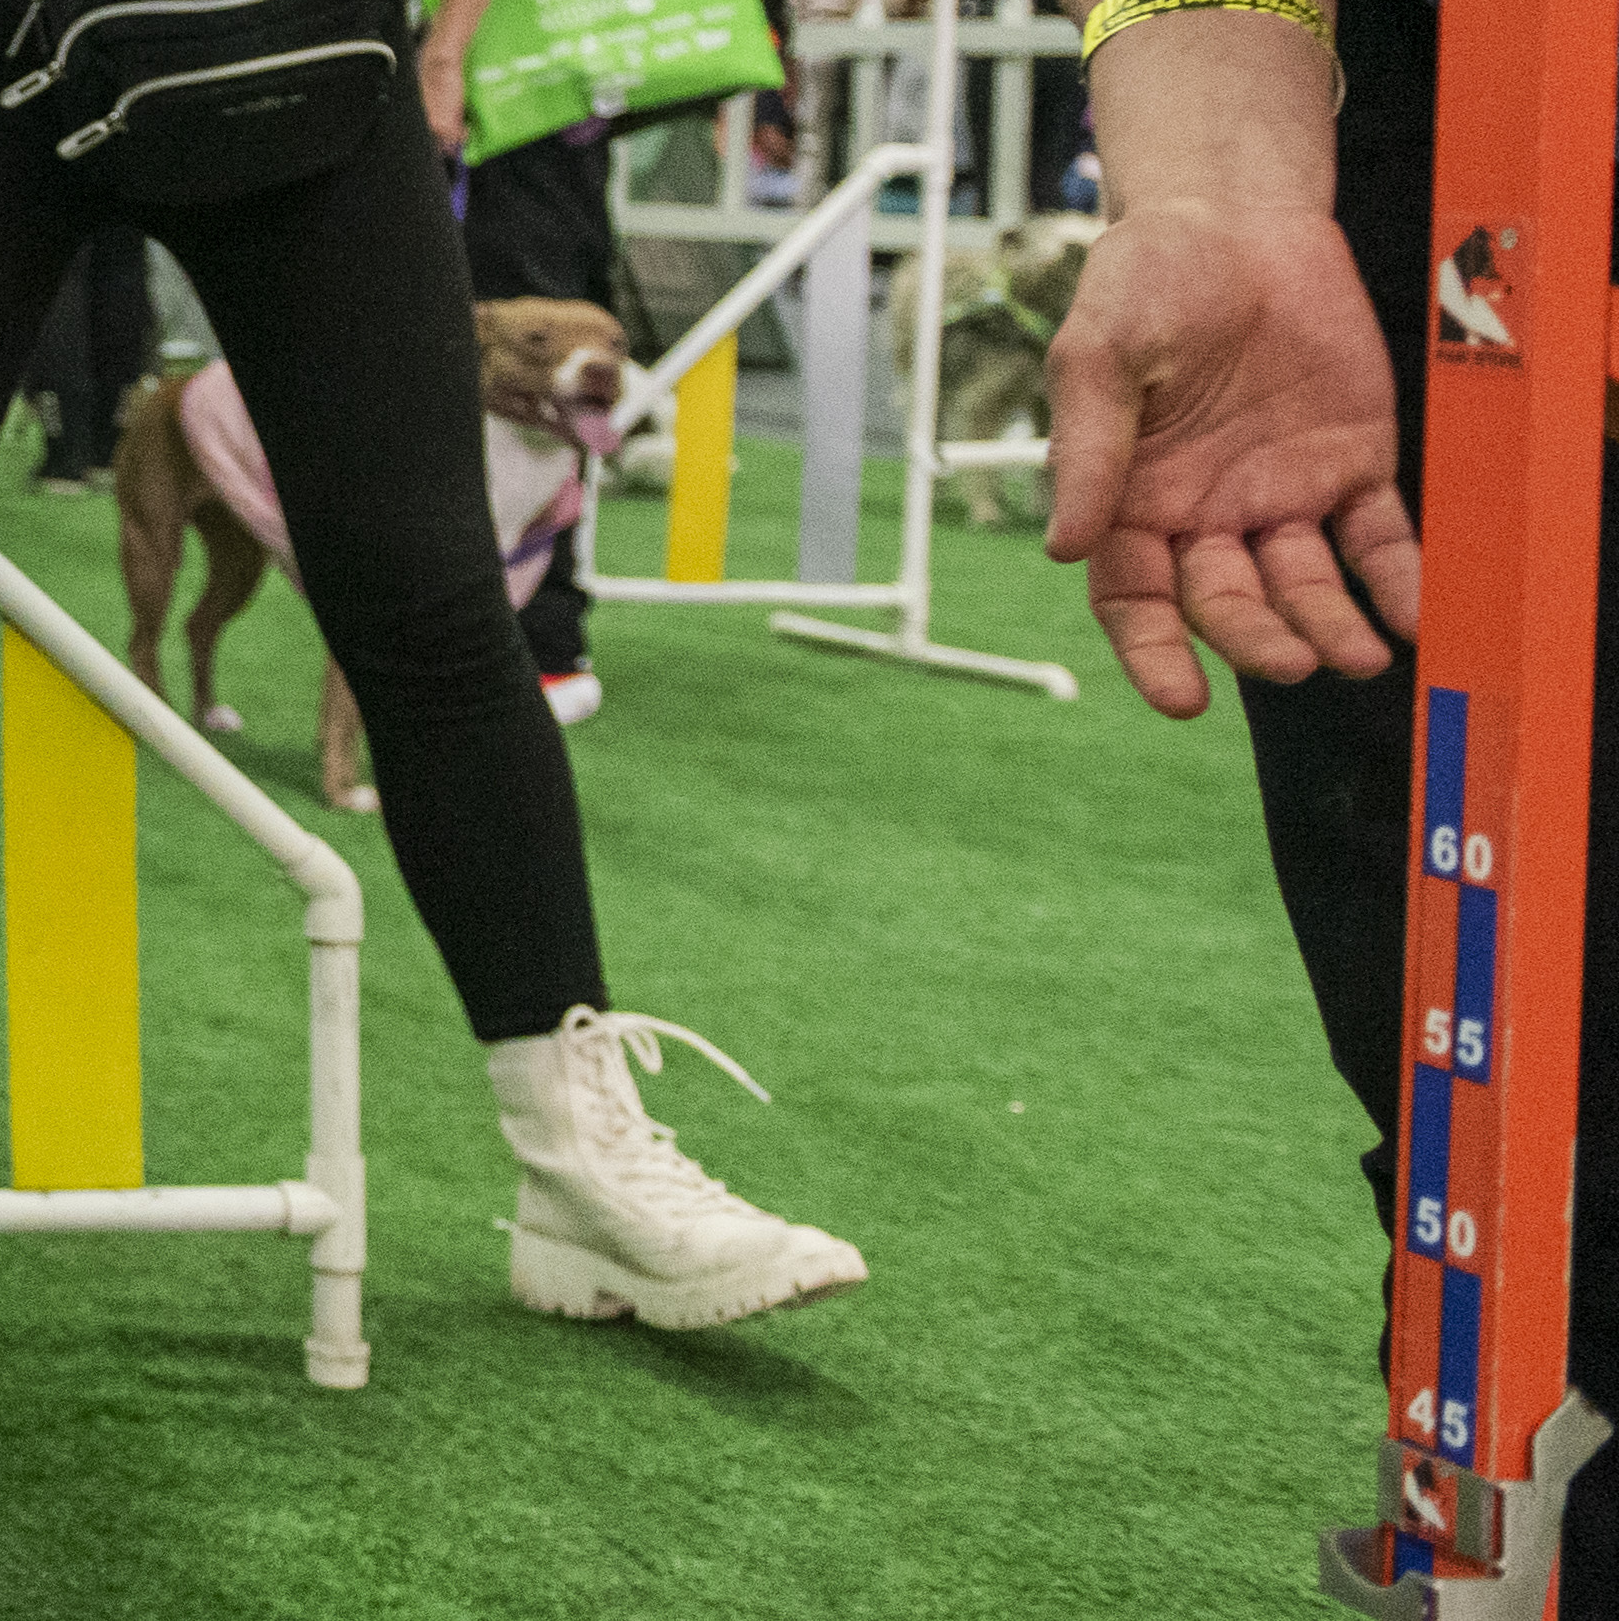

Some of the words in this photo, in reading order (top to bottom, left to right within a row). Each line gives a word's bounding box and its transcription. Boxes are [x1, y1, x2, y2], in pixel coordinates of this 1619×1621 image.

[1430, 825, 1493, 883] 60
[1424, 1008, 1485, 1069] 55
[1415, 1196, 1477, 1259] 50
[1407, 1387, 1470, 1450] 45
